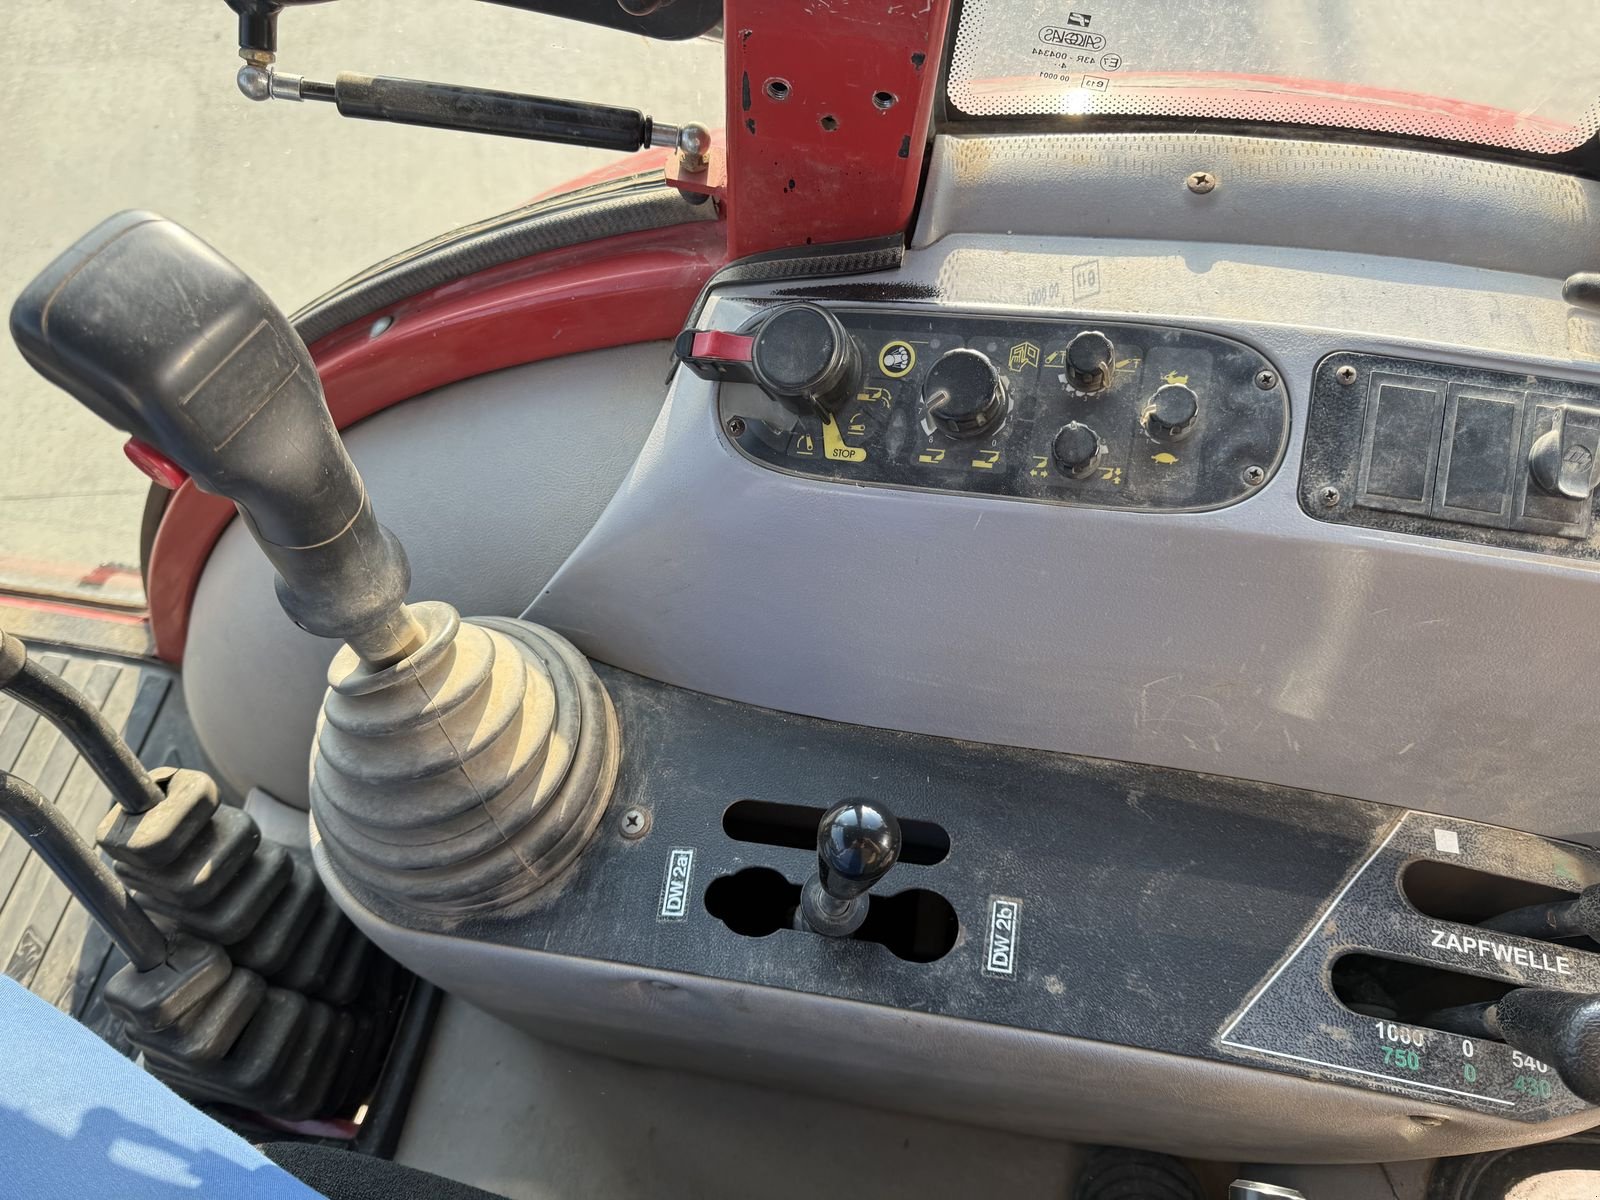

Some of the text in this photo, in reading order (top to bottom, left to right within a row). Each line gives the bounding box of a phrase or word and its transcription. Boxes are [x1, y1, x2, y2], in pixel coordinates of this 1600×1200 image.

[832, 448, 856, 458] STOP
[666, 855, 689, 910] DW 2a
[992, 907, 1013, 967] DW 2b
[1430, 929, 1571, 975] ZAPFWELLE
[1375, 1021, 1424, 1047] 1000
[1462, 1039, 1474, 1058] 0
[1380, 1046, 1550, 1097] 750 0 430
